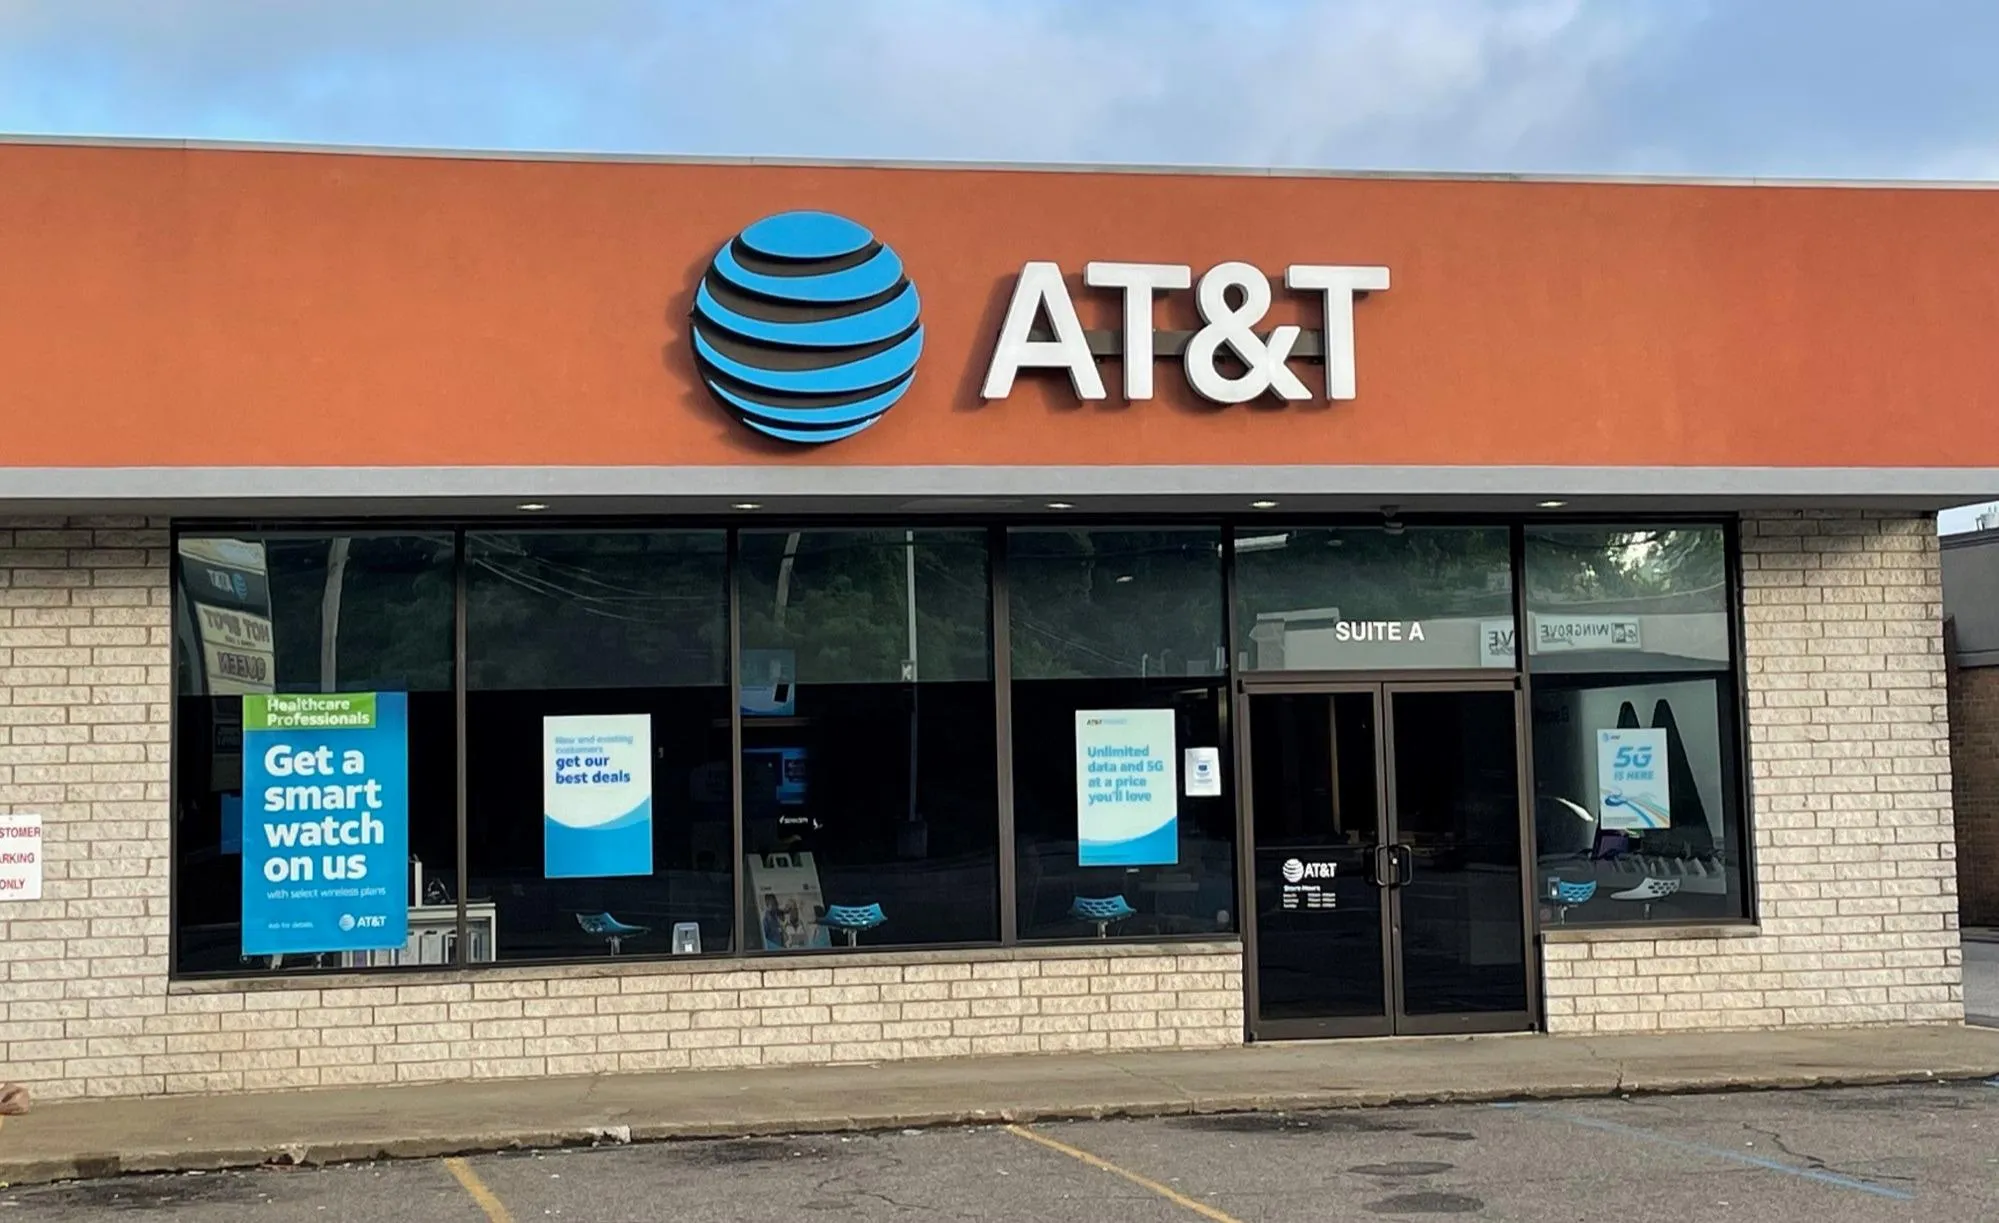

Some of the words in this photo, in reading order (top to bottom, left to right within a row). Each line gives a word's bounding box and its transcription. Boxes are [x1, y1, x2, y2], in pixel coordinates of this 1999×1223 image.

[980, 261, 1390, 403] AT&T
[1335, 621, 1402, 642] SUITE
[1409, 621, 1425, 641] A
[267, 698, 350, 711] Healthcare
[267, 712, 370, 726] Professionals
[1088, 745, 1150, 757] Unlimited
[1613, 746, 1652, 768] 5G
[264, 745, 334, 777] Get
[342, 750, 365, 774] a
[556, 756, 580, 771] get
[585, 757, 610, 767] our
[1088, 761, 1117, 772] data
[1120, 761, 1145, 772] and
[1147, 761, 1163, 772] 5G
[556, 772, 588, 784] best
[592, 770, 631, 783] deals
[1088, 777, 1101, 788] at
[1105, 779, 1112, 787] a
[1115, 776, 1146, 791] price
[1614, 772, 1625, 781] IS
[1627, 771, 1654, 780] HERE
[264, 779, 383, 811] smart
[1088, 790, 1122, 805] you'll
[1126, 790, 1151, 802] love
[264, 812, 385, 847] watch
[0, 852, 35, 864] RKING
[264, 856, 314, 882] on
[322, 854, 367, 879] us
[1304, 862, 1337, 878] AT&T
[0, 879, 25, 890] ONLY
[291, 888, 318, 898] select
[321, 887, 358, 896] wireless
[360, 887, 386, 897] plans
[357, 916, 387, 928] AT&T
